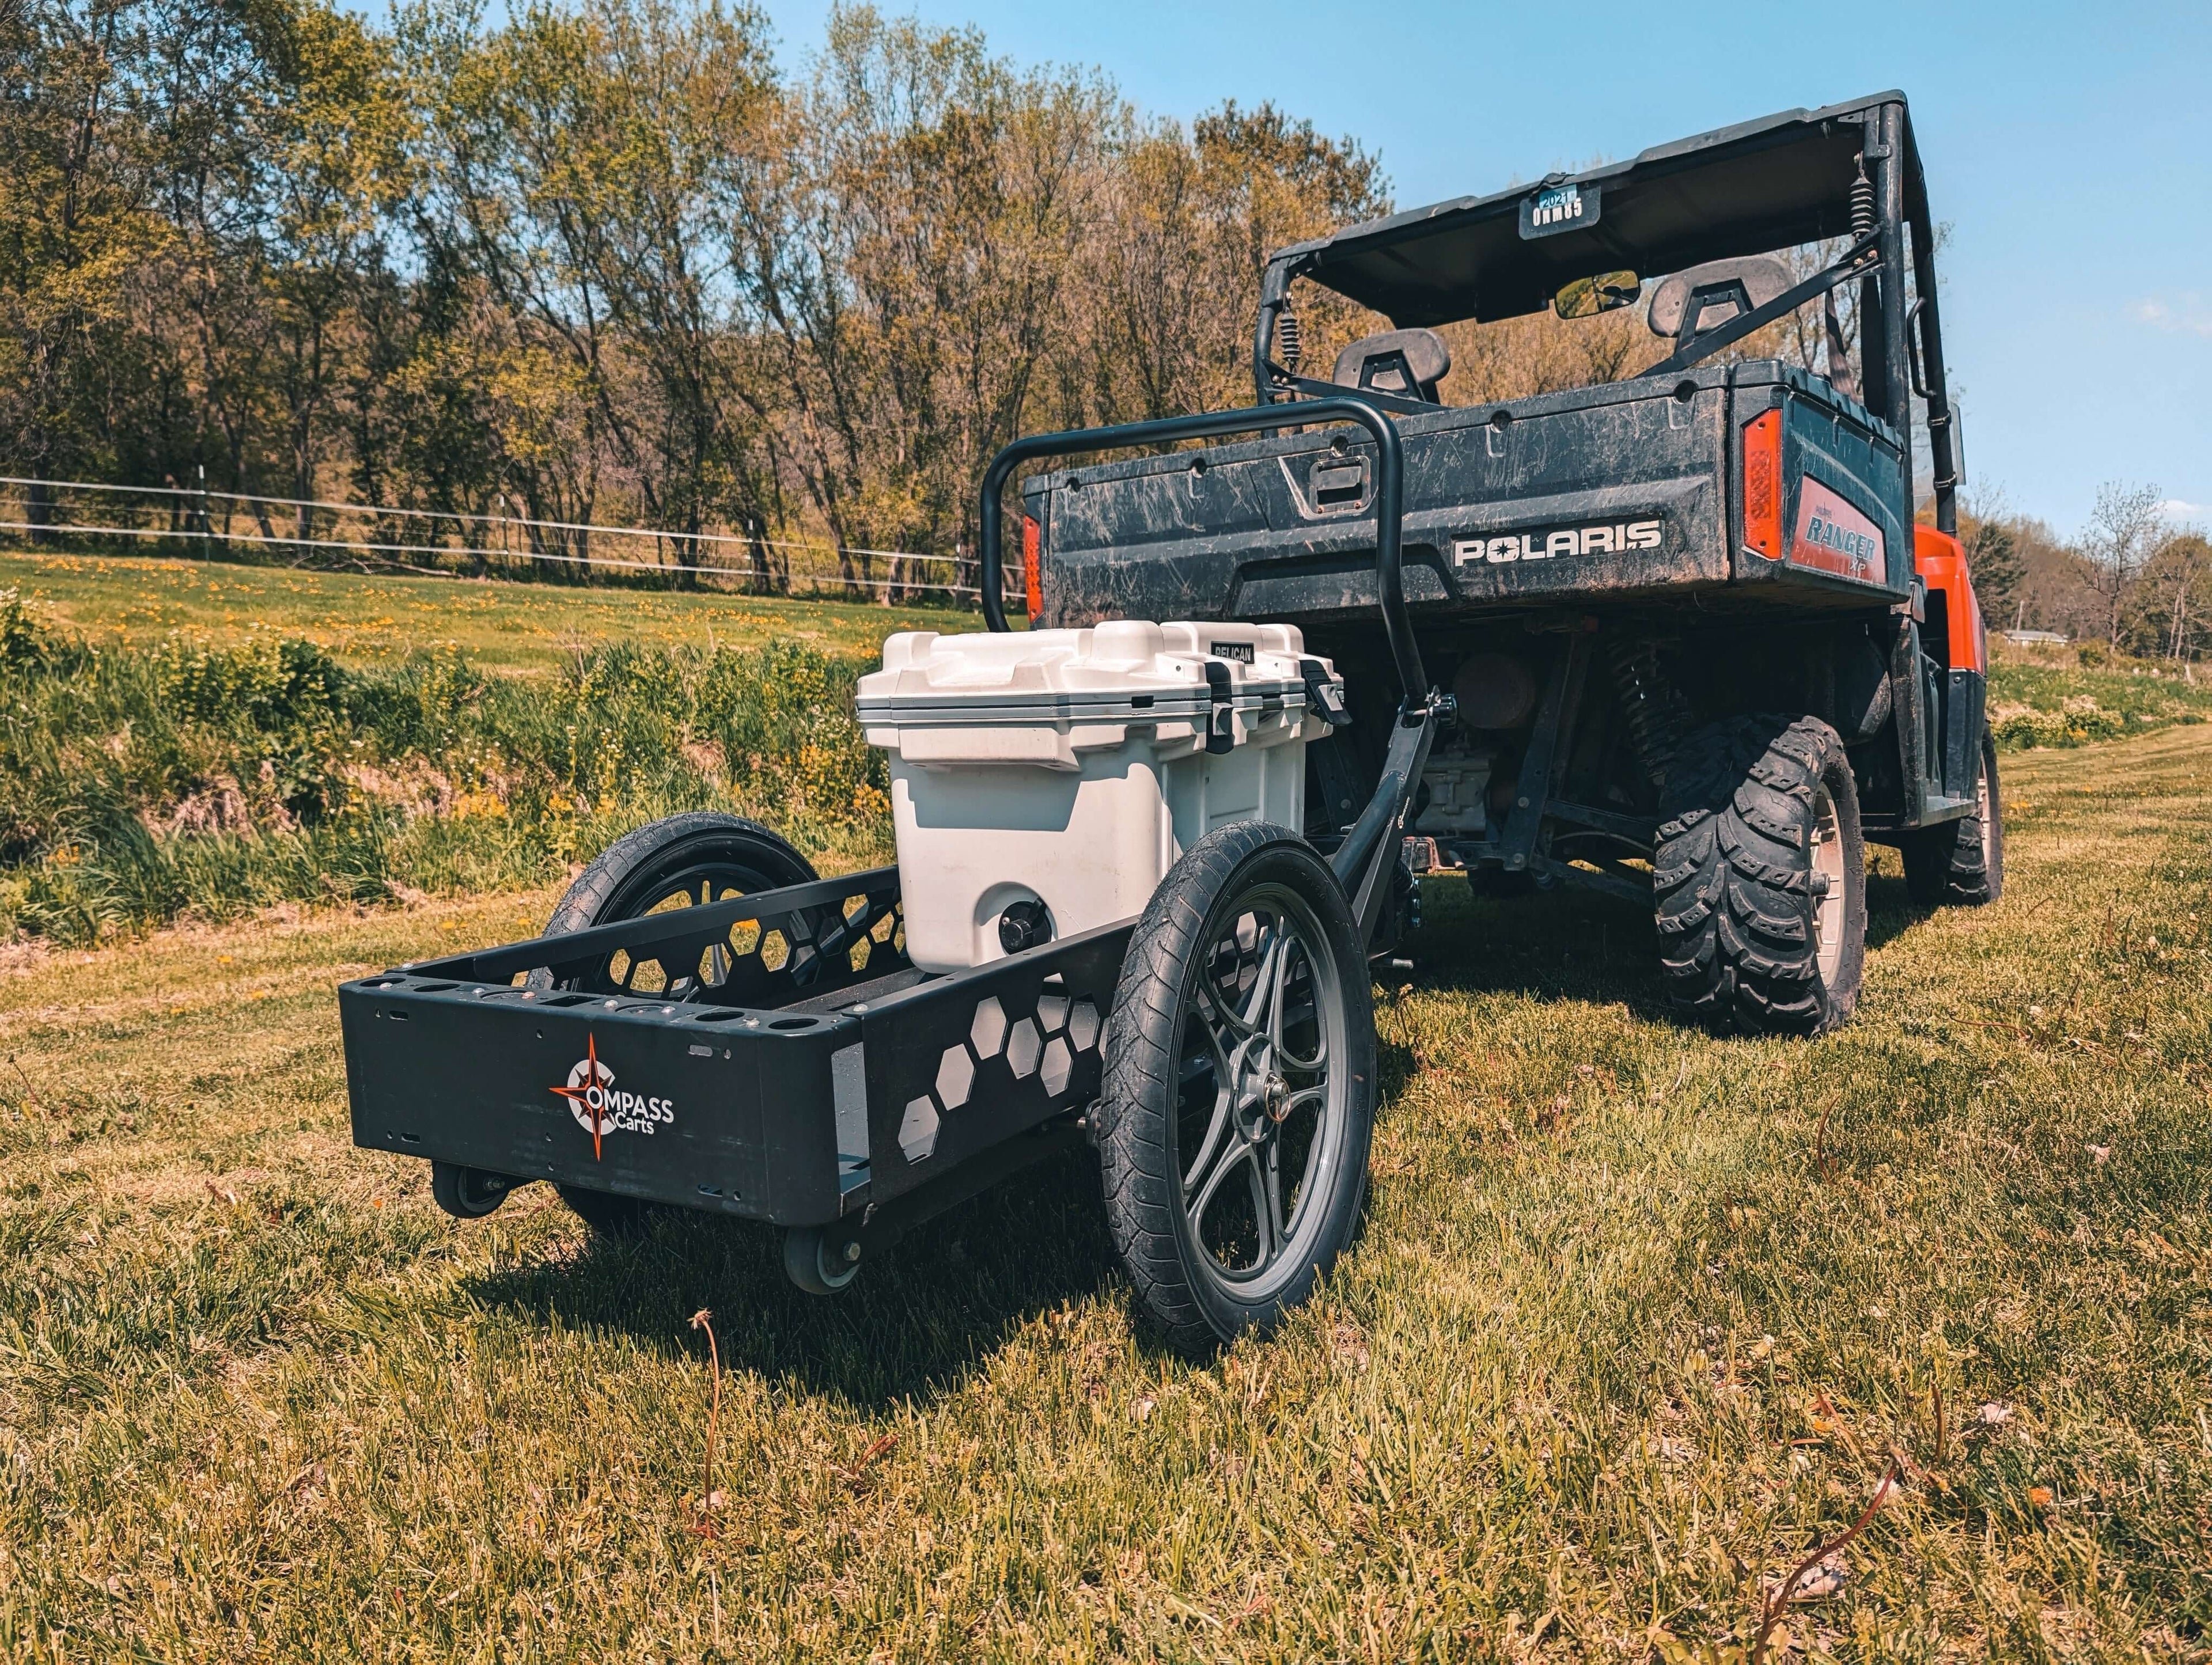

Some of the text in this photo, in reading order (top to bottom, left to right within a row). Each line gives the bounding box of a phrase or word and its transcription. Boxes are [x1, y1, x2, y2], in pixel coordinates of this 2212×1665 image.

[1543, 192, 1568, 208] 2021
[1455, 519, 1662, 567] POLARIS
[1805, 515, 1876, 562] RANGER
[1849, 560, 1866, 573] XP
[1215, 646, 1251, 662] PELICAN
[567, 1059, 675, 1136] COMPASS
[615, 1111, 655, 1135] Carts
